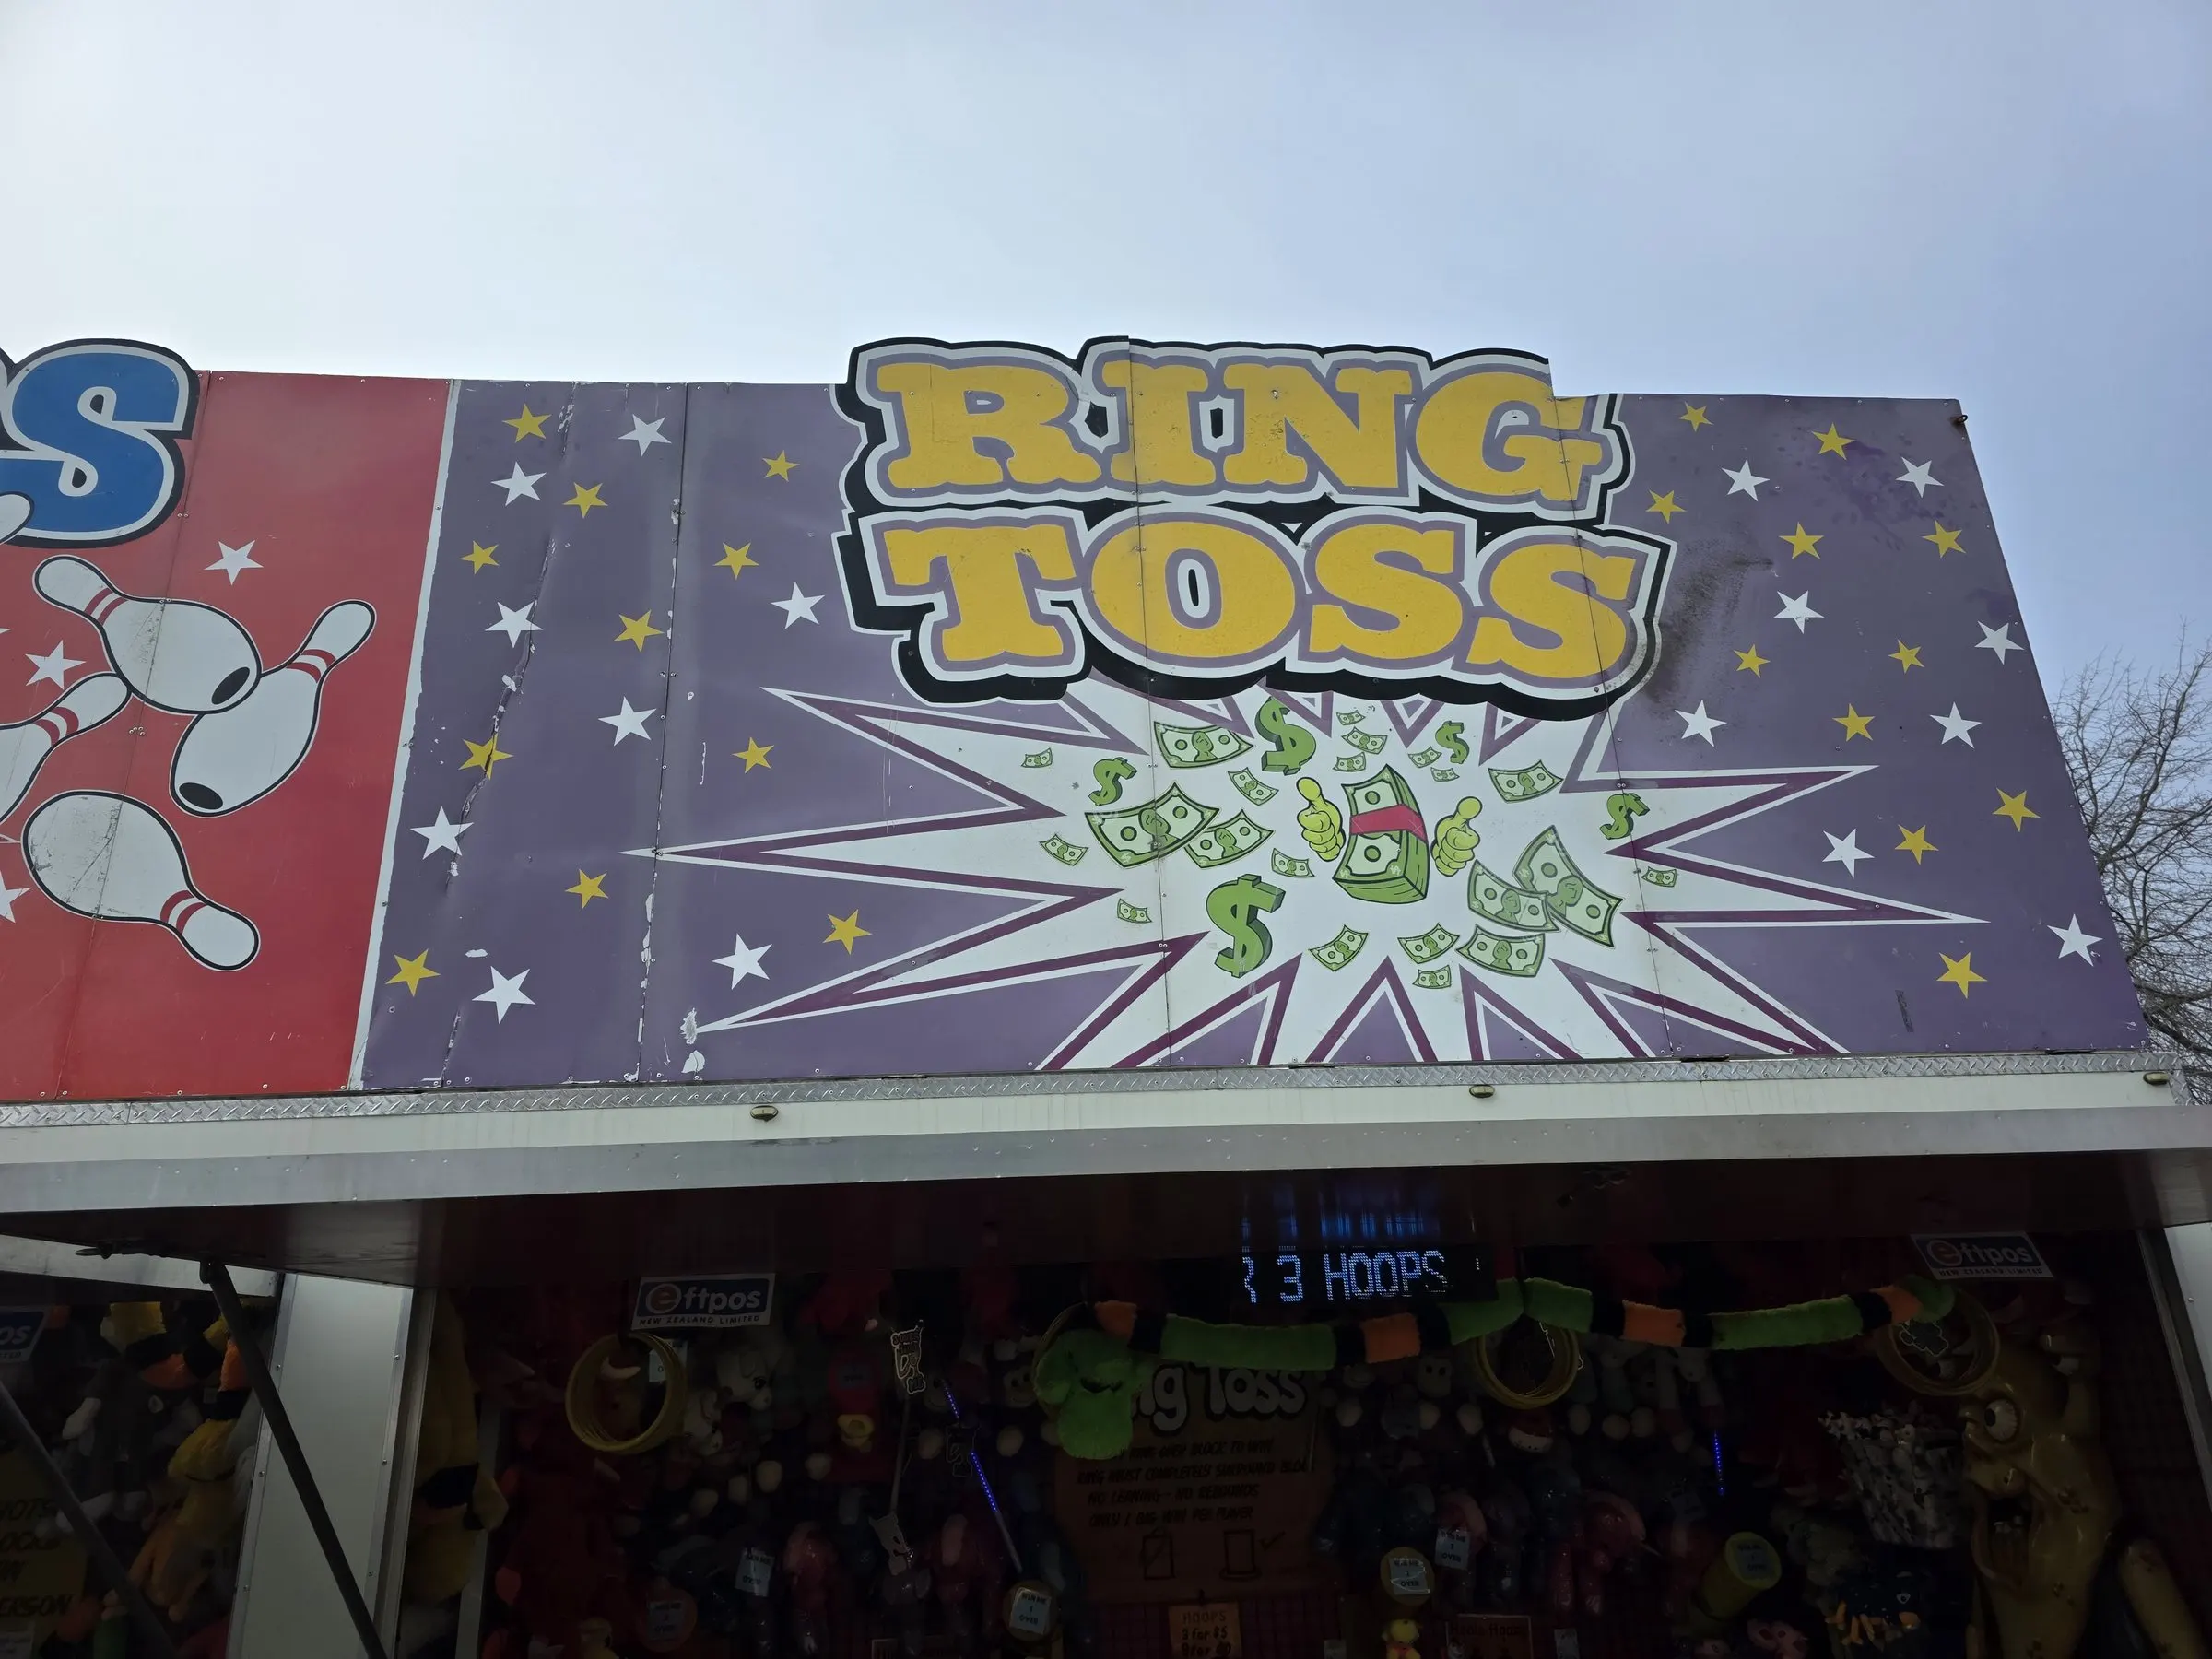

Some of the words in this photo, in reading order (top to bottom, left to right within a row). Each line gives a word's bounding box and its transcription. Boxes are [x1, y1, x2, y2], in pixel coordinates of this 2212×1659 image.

[865, 355, 1611, 509] RING
[871, 516, 1642, 680] TOSS
[1926, 1240, 2034, 1266] eftpos
[1277, 1254, 1305, 1302] 3
[1324, 1250, 1450, 1300] HOOPS
[646, 1283, 762, 1314] eftpos
[639, 1317, 663, 1325] NEW
[719, 1314, 760, 1324] LIMITED
[1107, 1467, 1142, 1483] MUST
[1088, 1490, 1106, 1505] NO
[1174, 1486, 1193, 1502] NO
[1182, 1628, 1189, 1640] 3
[1192, 1627, 1211, 1640] for
[1182, 1642, 1189, 1656] 9
[1190, 1643, 1211, 1657] for
